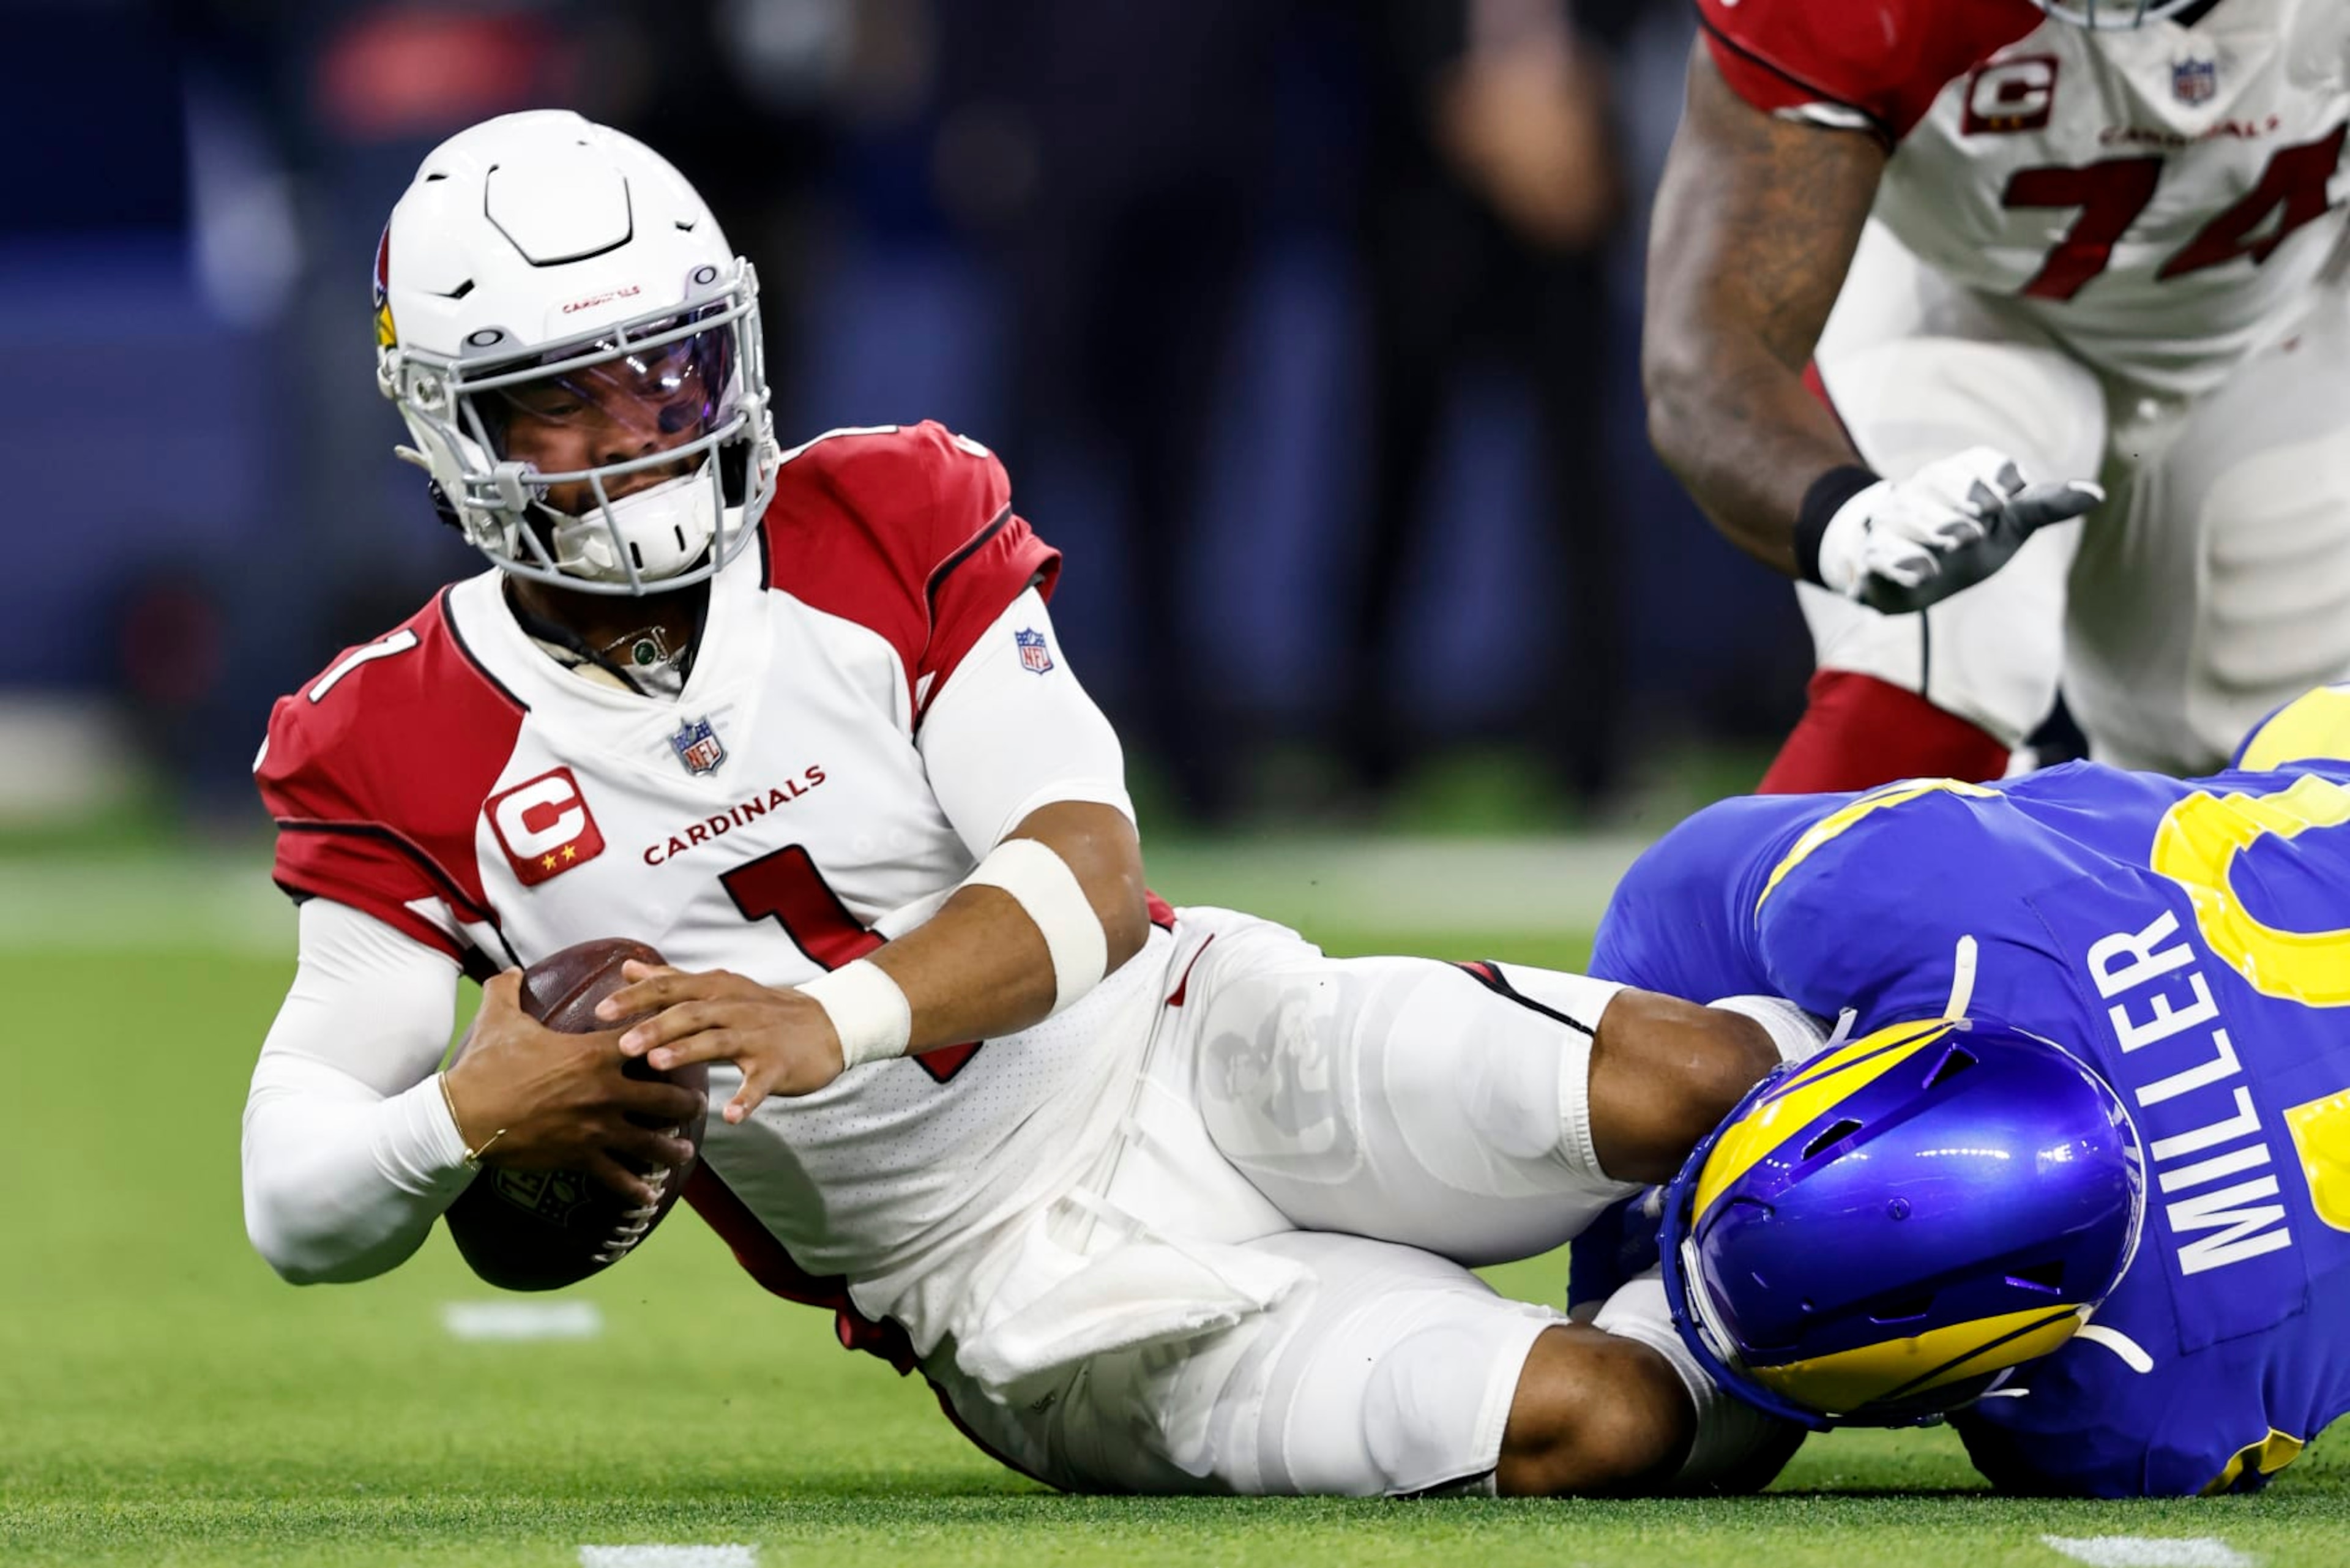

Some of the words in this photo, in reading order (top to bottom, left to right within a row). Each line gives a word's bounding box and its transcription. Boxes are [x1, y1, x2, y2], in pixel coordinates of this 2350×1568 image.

[1971, 61, 2051, 119] C
[2098, 114, 2280, 146] CARDALS
[2002, 122, 2350, 304] 74
[563, 286, 640, 313] CARDALS
[308, 628, 420, 704] 1
[496, 775, 586, 859] C
[644, 764, 827, 867] CARDINALS
[2086, 909, 2292, 1277] MILLER
